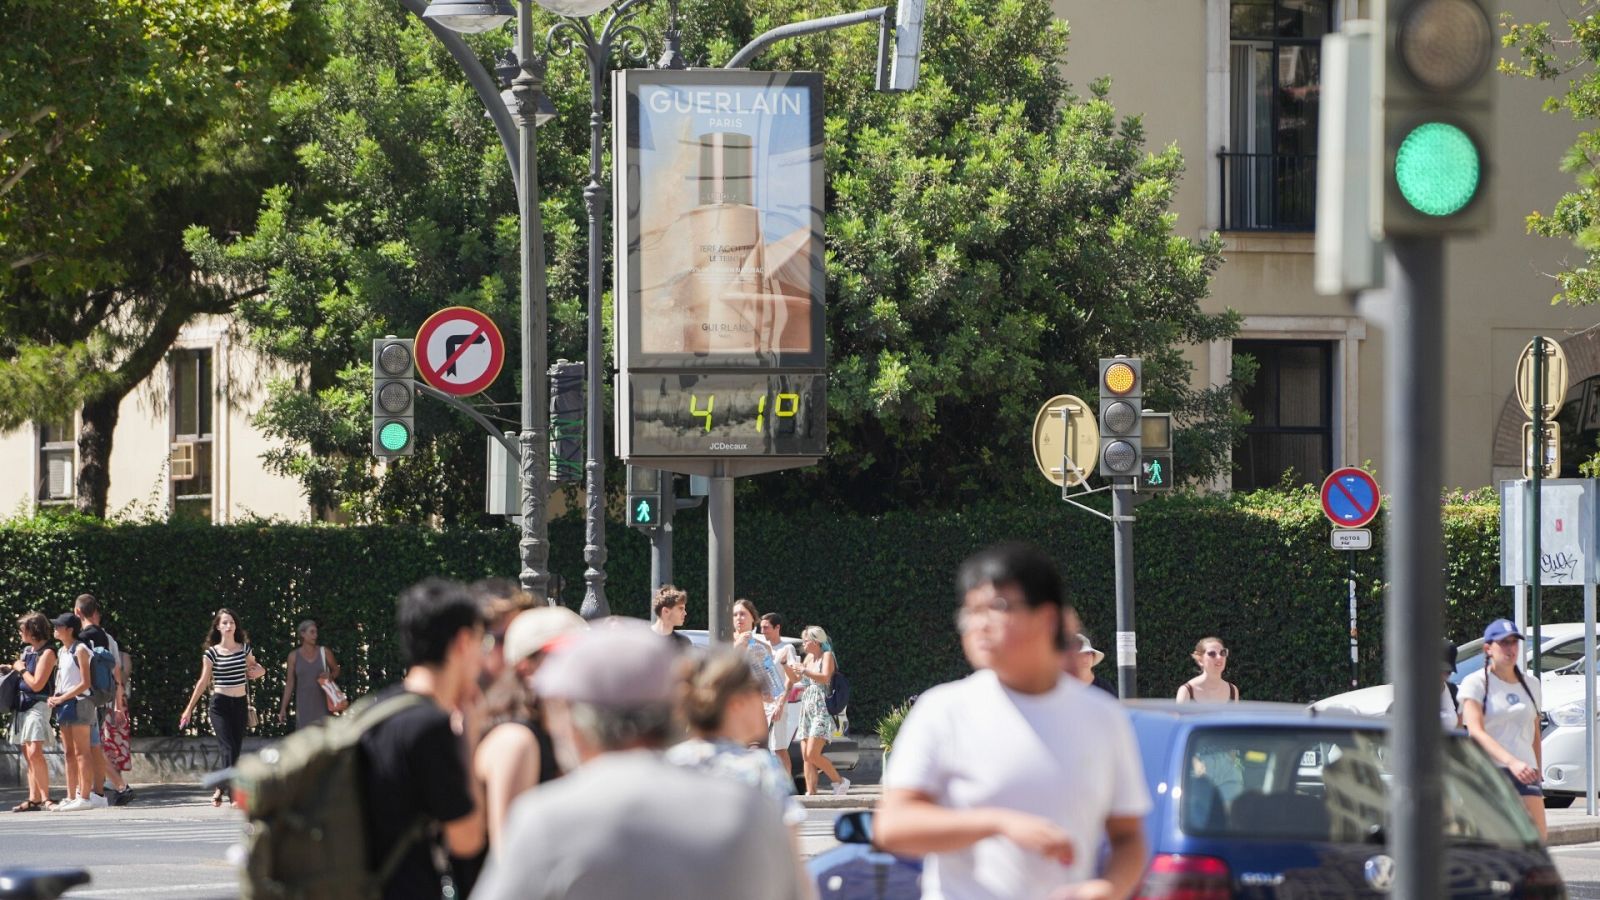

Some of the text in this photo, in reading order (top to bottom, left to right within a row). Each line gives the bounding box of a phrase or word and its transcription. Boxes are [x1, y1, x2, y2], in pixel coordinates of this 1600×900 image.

[649, 90, 801, 115] GUERLAIN
[708, 118, 744, 128] PARIS
[709, 442, 748, 450] JCDecaux
